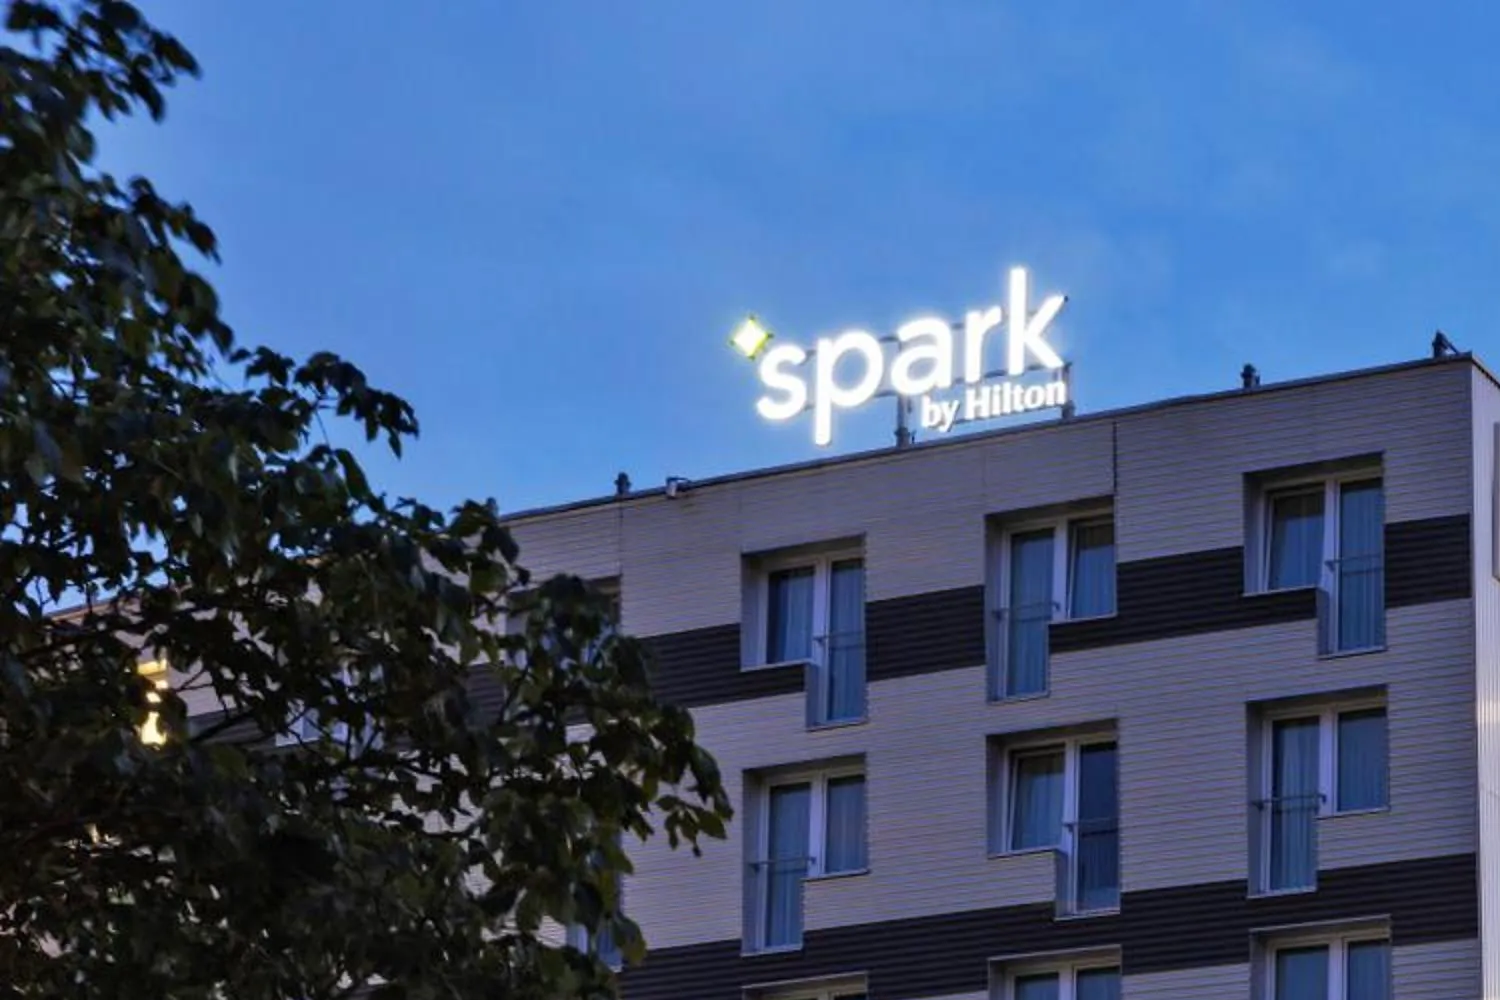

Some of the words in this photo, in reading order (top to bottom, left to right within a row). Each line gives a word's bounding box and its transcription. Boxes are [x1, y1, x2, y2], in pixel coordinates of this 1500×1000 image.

[756, 267, 1065, 446] spark
[921, 394, 959, 432] by
[964, 381, 1067, 420] Hilton
